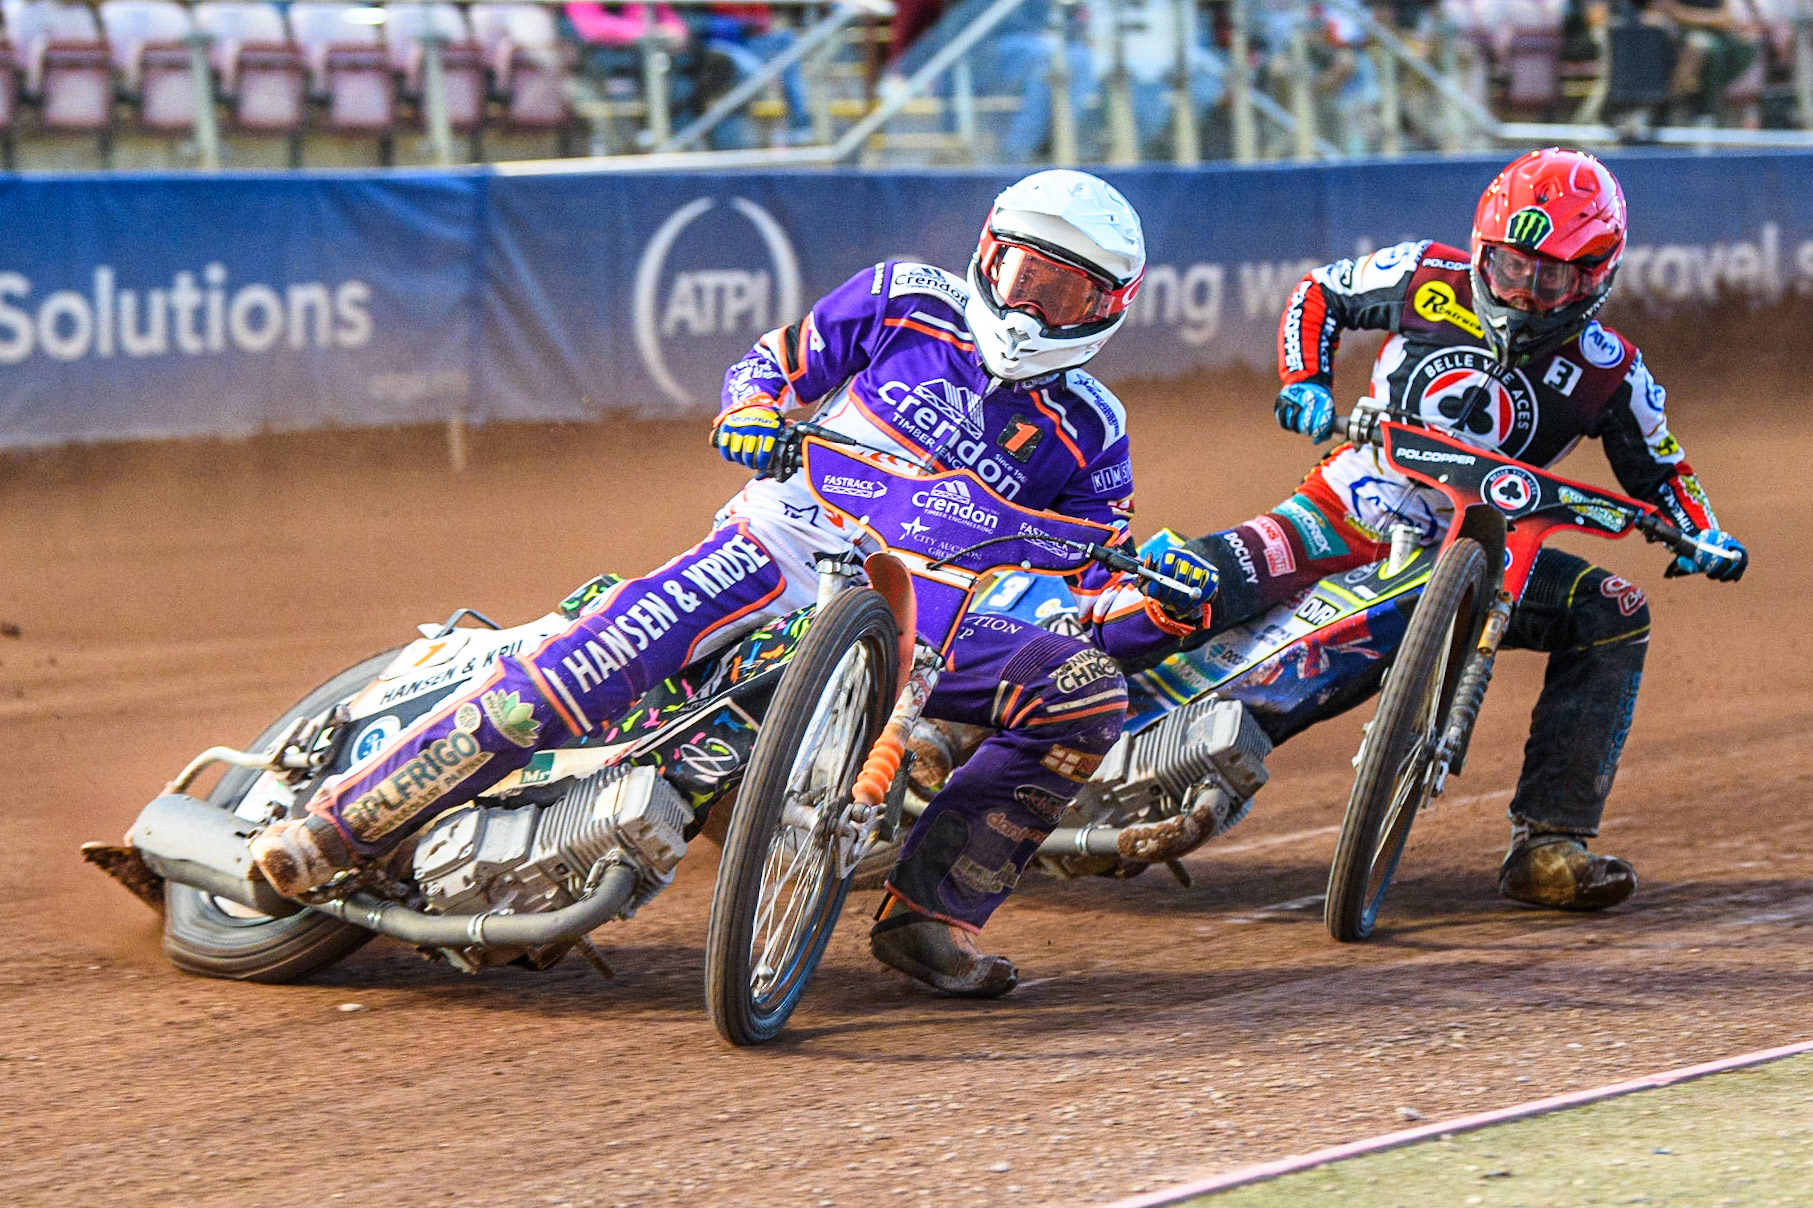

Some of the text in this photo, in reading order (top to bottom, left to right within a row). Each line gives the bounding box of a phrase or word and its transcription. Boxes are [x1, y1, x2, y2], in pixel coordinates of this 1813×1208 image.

[894, 274, 969, 304] Crendon
[0, 262, 373, 364] Solutions
[1549, 360, 1575, 391] 3
[1424, 354, 1474, 379] BELLE
[1511, 389, 1531, 430] ACES
[877, 380, 1021, 501] Crendon
[892, 411, 937, 449] TIMBER
[1004, 421, 1039, 452] 1
[993, 452, 1014, 472] Since
[1396, 447, 1476, 466] POLCOPPER
[823, 474, 876, 491] FASTRACK
[911, 490, 999, 529] Crendon
[913, 531, 938, 546] CITY
[1223, 531, 1259, 584] DOCUFY
[561, 534, 771, 694] HANSEN & KRUSE
[412, 641, 448, 668] 1
[379, 665, 458, 706] HANSEN
[461, 656, 477, 675] &
[522, 769, 551, 784] Mr
